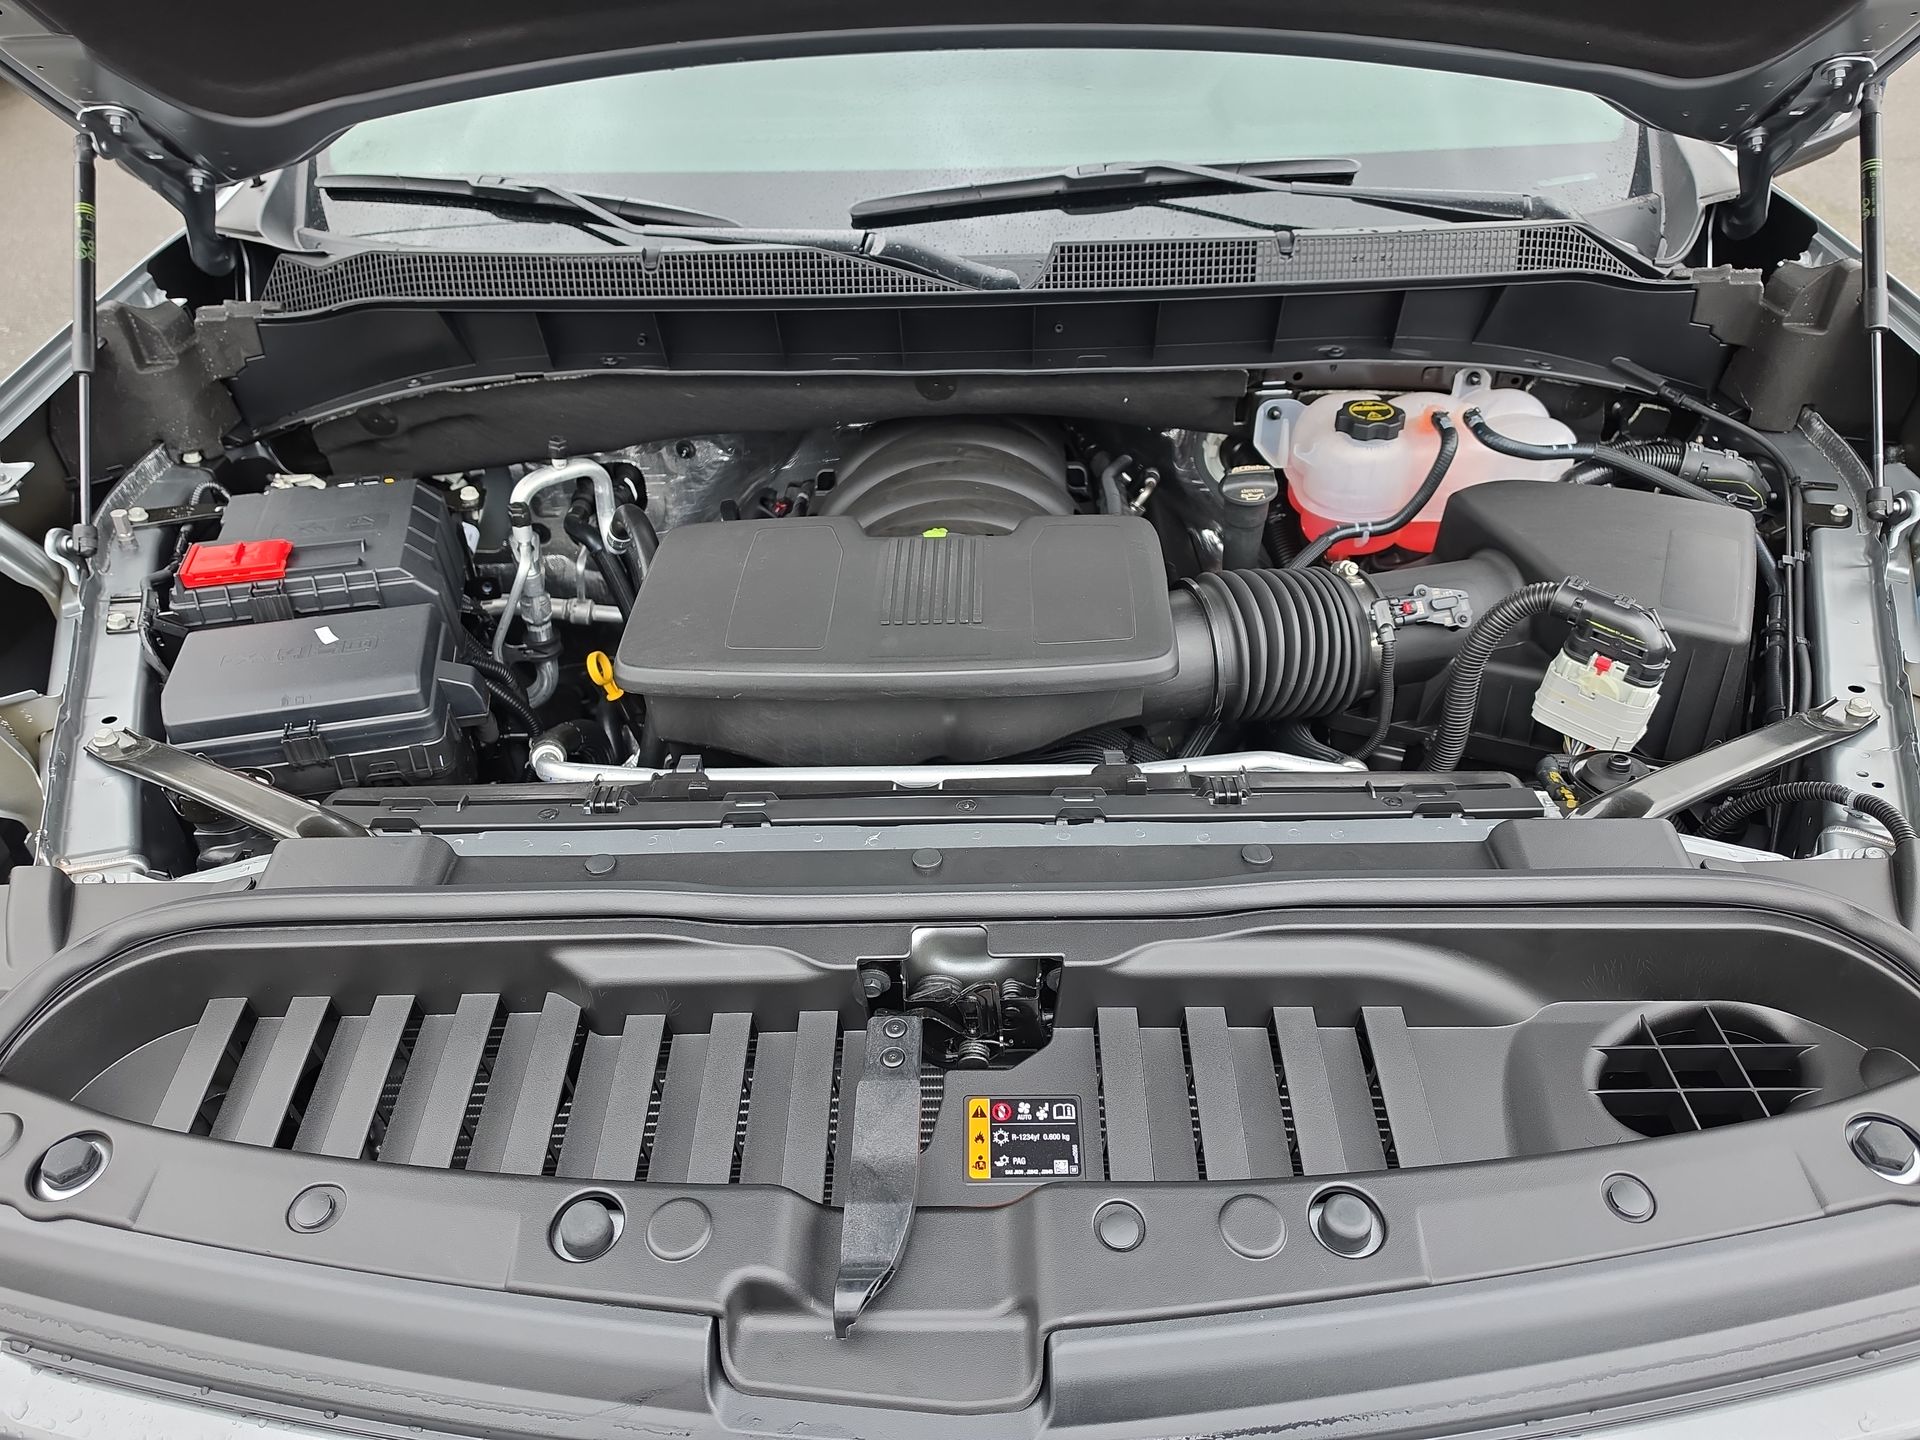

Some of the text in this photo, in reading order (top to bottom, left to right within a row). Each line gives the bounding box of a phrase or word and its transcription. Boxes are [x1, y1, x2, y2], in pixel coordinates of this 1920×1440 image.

[1012, 1133, 1040, 1142] R-1234yf
[1062, 1132, 1070, 1142] kg
[1012, 1157, 1026, 1165] PAG
